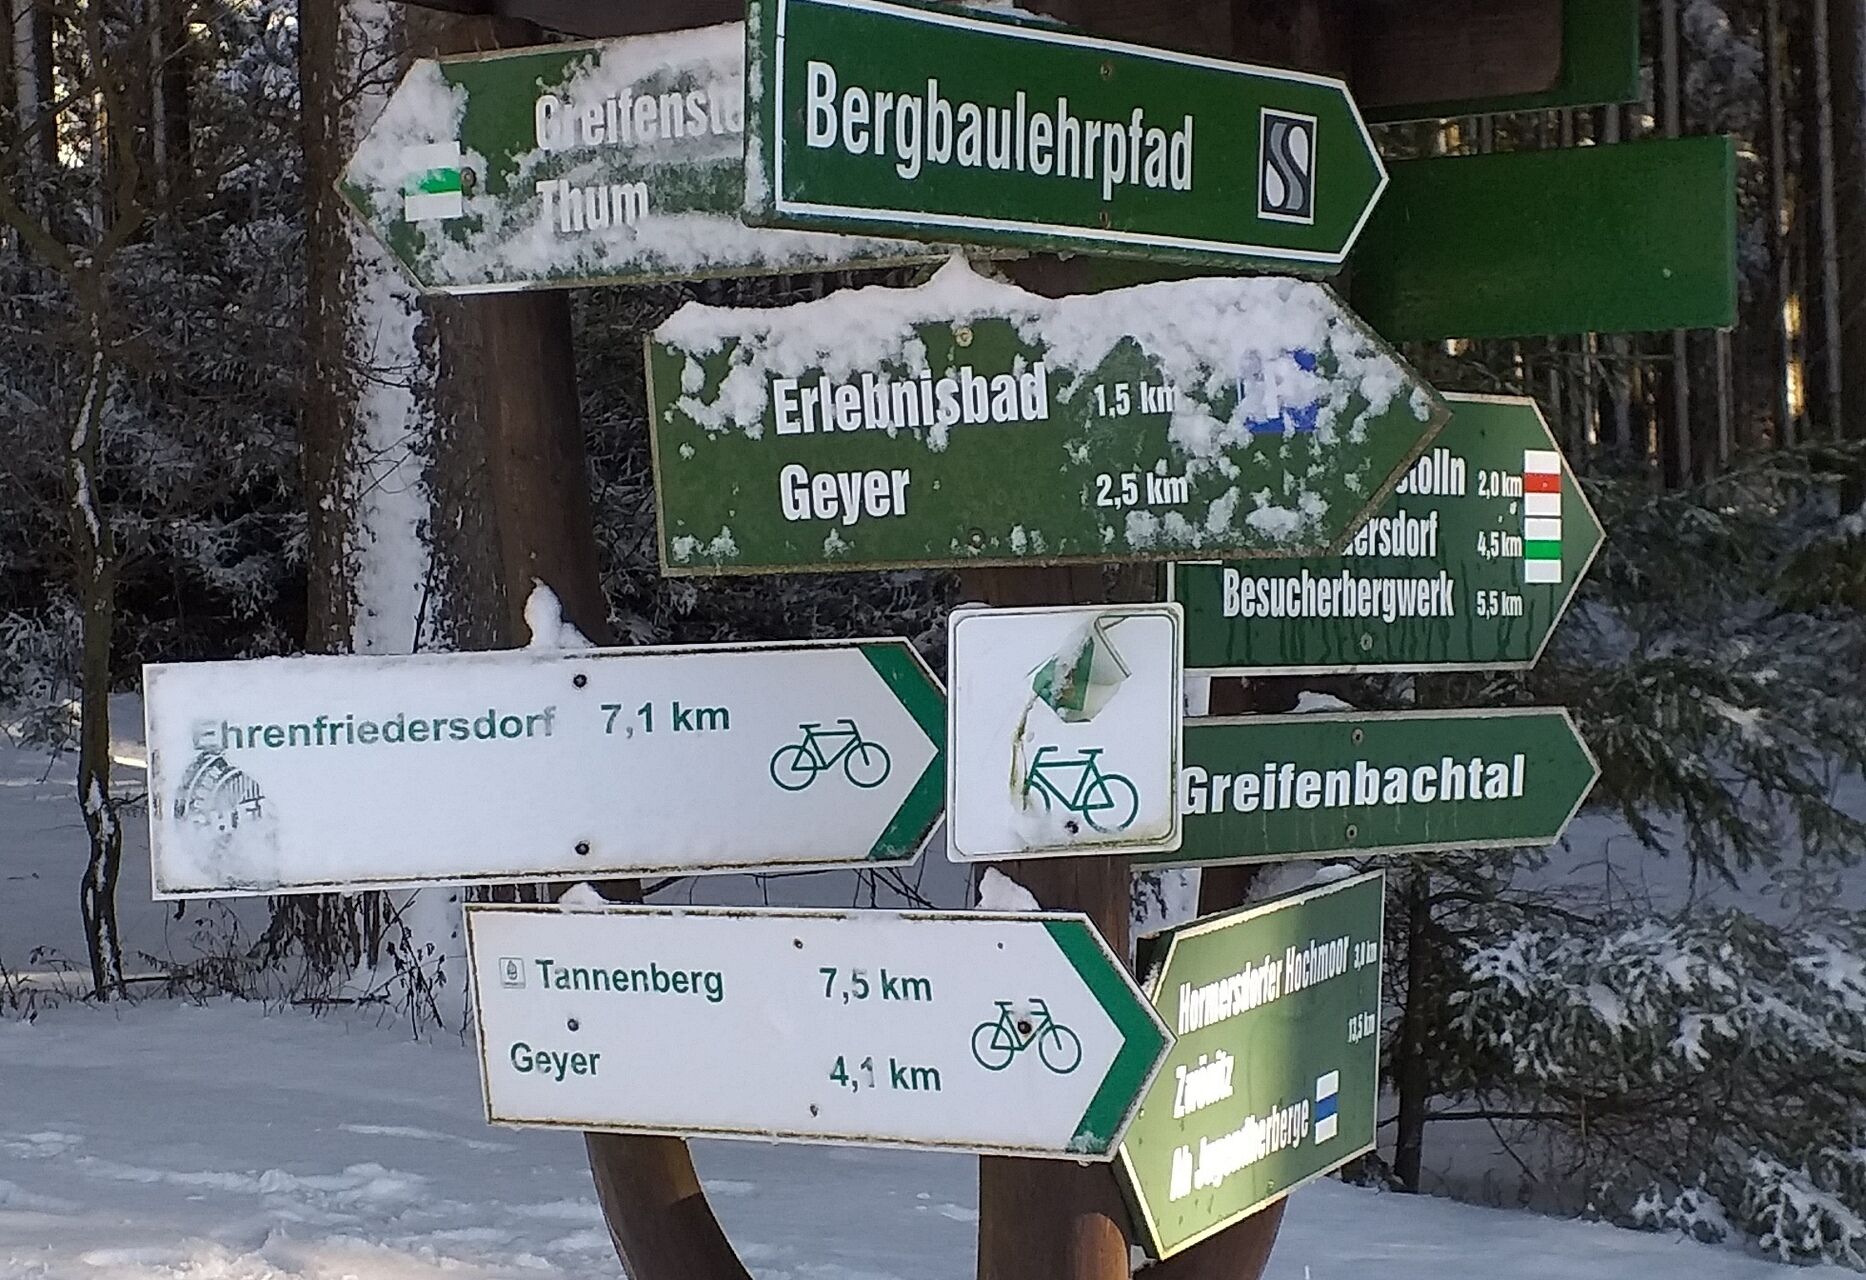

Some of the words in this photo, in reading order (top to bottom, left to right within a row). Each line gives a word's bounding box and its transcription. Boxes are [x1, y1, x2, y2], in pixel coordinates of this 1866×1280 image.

[806, 60, 1193, 201] Bergbaulehrpfad
[536, 179, 649, 233] Thum
[773, 361, 1049, 435] Erlebnisbad
[1095, 382, 1131, 418] 1,5
[1141, 382, 1180, 416] km
[780, 464, 911, 526] Geyer
[1096, 475, 1138, 510] 2,5
[1146, 472, 1189, 507] km
[1478, 470, 1500, 500] 2,0
[1501, 471, 1523, 498] km
[1341, 509, 1438, 558] ersdorf
[1477, 531, 1500, 561] 4,5
[1501, 531, 1523, 558] km
[1223, 567, 1455, 623] Besucherbergwerk
[1477, 590, 1500, 620] 5,5
[1501, 590, 1523, 618] km
[193, 706, 556, 752] Ehrenfriedersdorf
[601, 703, 654, 738] 7,1
[673, 700, 730, 734] km
[1182, 753, 1526, 815] Greifenbachtal
[535, 959, 724, 1001] Tannenberg
[819, 967, 870, 1004] 7,5
[881, 969, 933, 1002] km
[1285, 935, 1350, 994] Hochmoor
[510, 1042, 601, 1082] Geyer
[829, 1055, 875, 1090] 4,1
[890, 1057, 942, 1092] km
